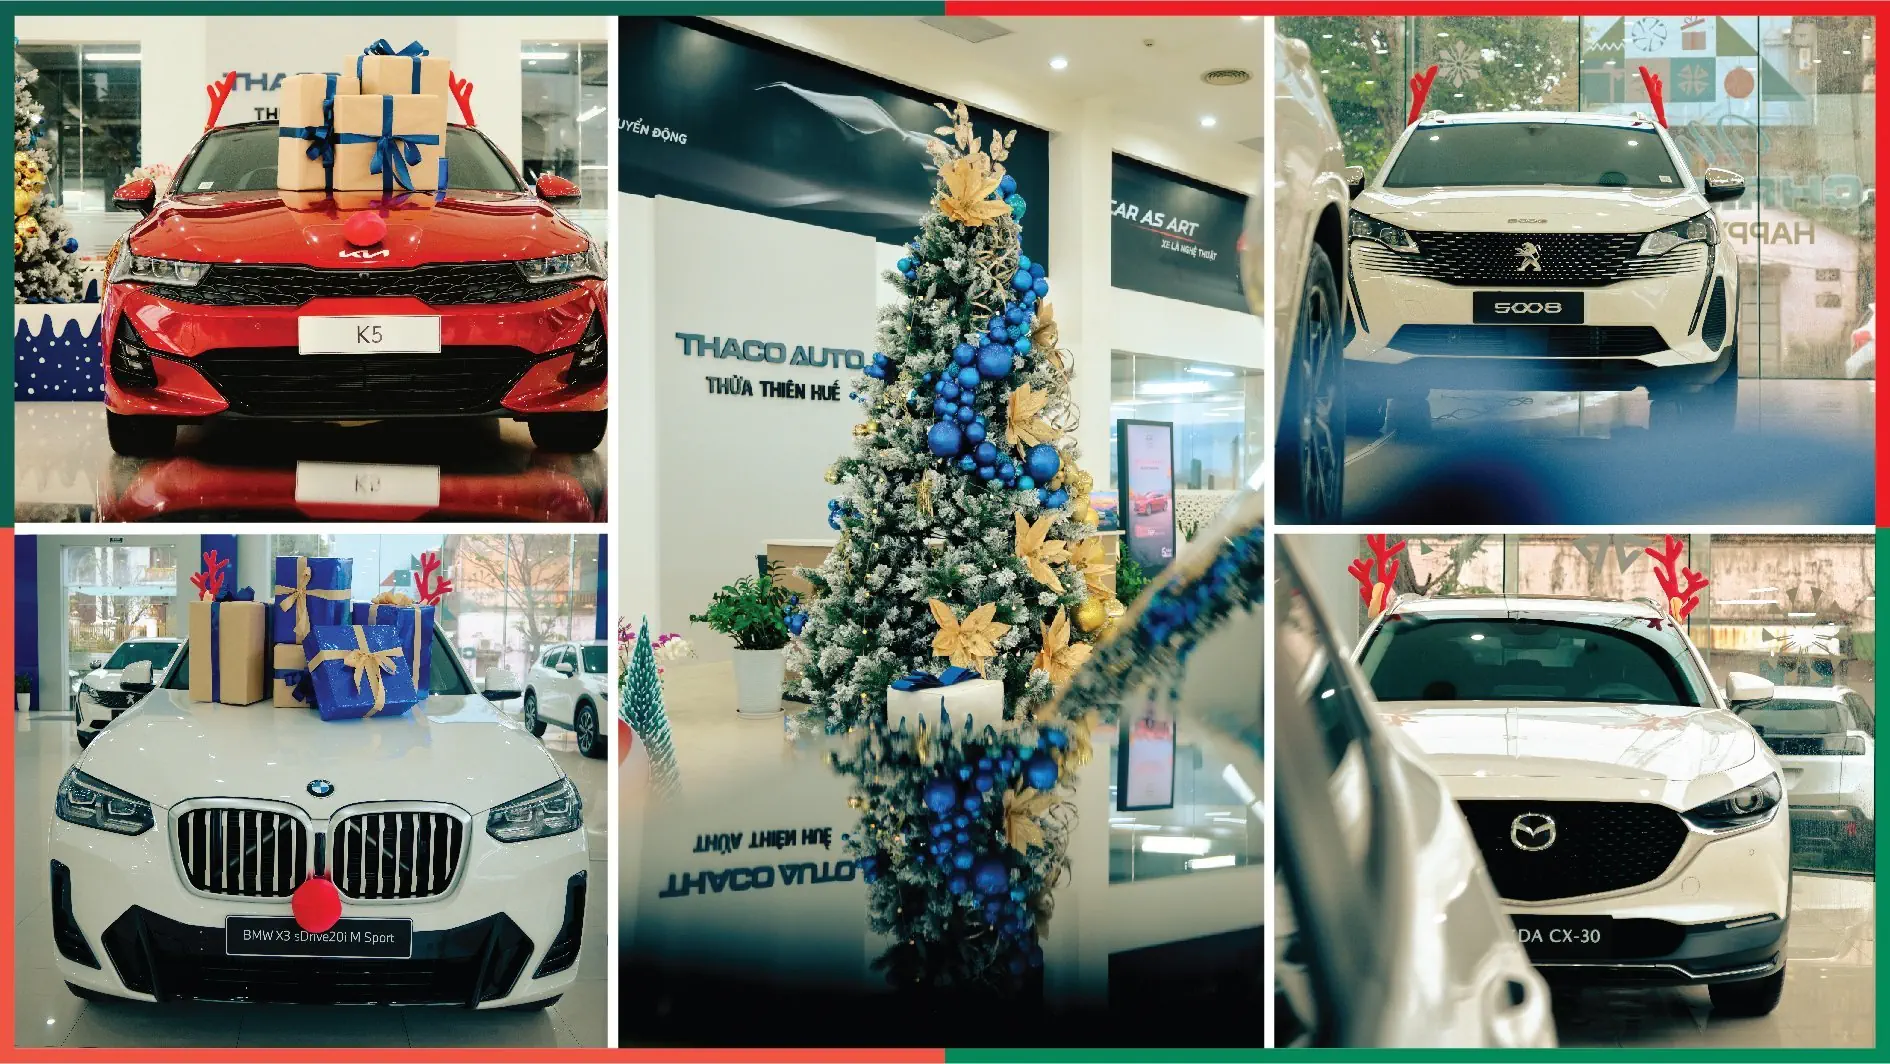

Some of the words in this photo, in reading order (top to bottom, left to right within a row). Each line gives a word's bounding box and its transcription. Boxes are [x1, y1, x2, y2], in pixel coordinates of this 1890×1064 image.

[254, 107, 280, 120] TH
[652, 127, 688, 145] ĐỘNG
[1140, 209, 1165, 228] AS
[1166, 217, 1200, 237] ART
[1161, 239, 1171, 249] XE
[1494, 302, 1563, 314] 5008
[357, 325, 383, 344] K5
[675, 331, 787, 364] THACO
[789, 345, 865, 370] AUTO
[705, 374, 753, 396] THỪA
[759, 379, 805, 400] THIÊN
[811, 379, 841, 401] HUẾ
[243, 929, 274, 941] BMW
[276, 930, 291, 941] X3
[294, 930, 347, 943] sDrive20i
[350, 931, 361, 943] M
[364, 931, 395, 946] Sport
[1512, 928, 1543, 943] DA
[1549, 928, 1600, 944] CX-30
